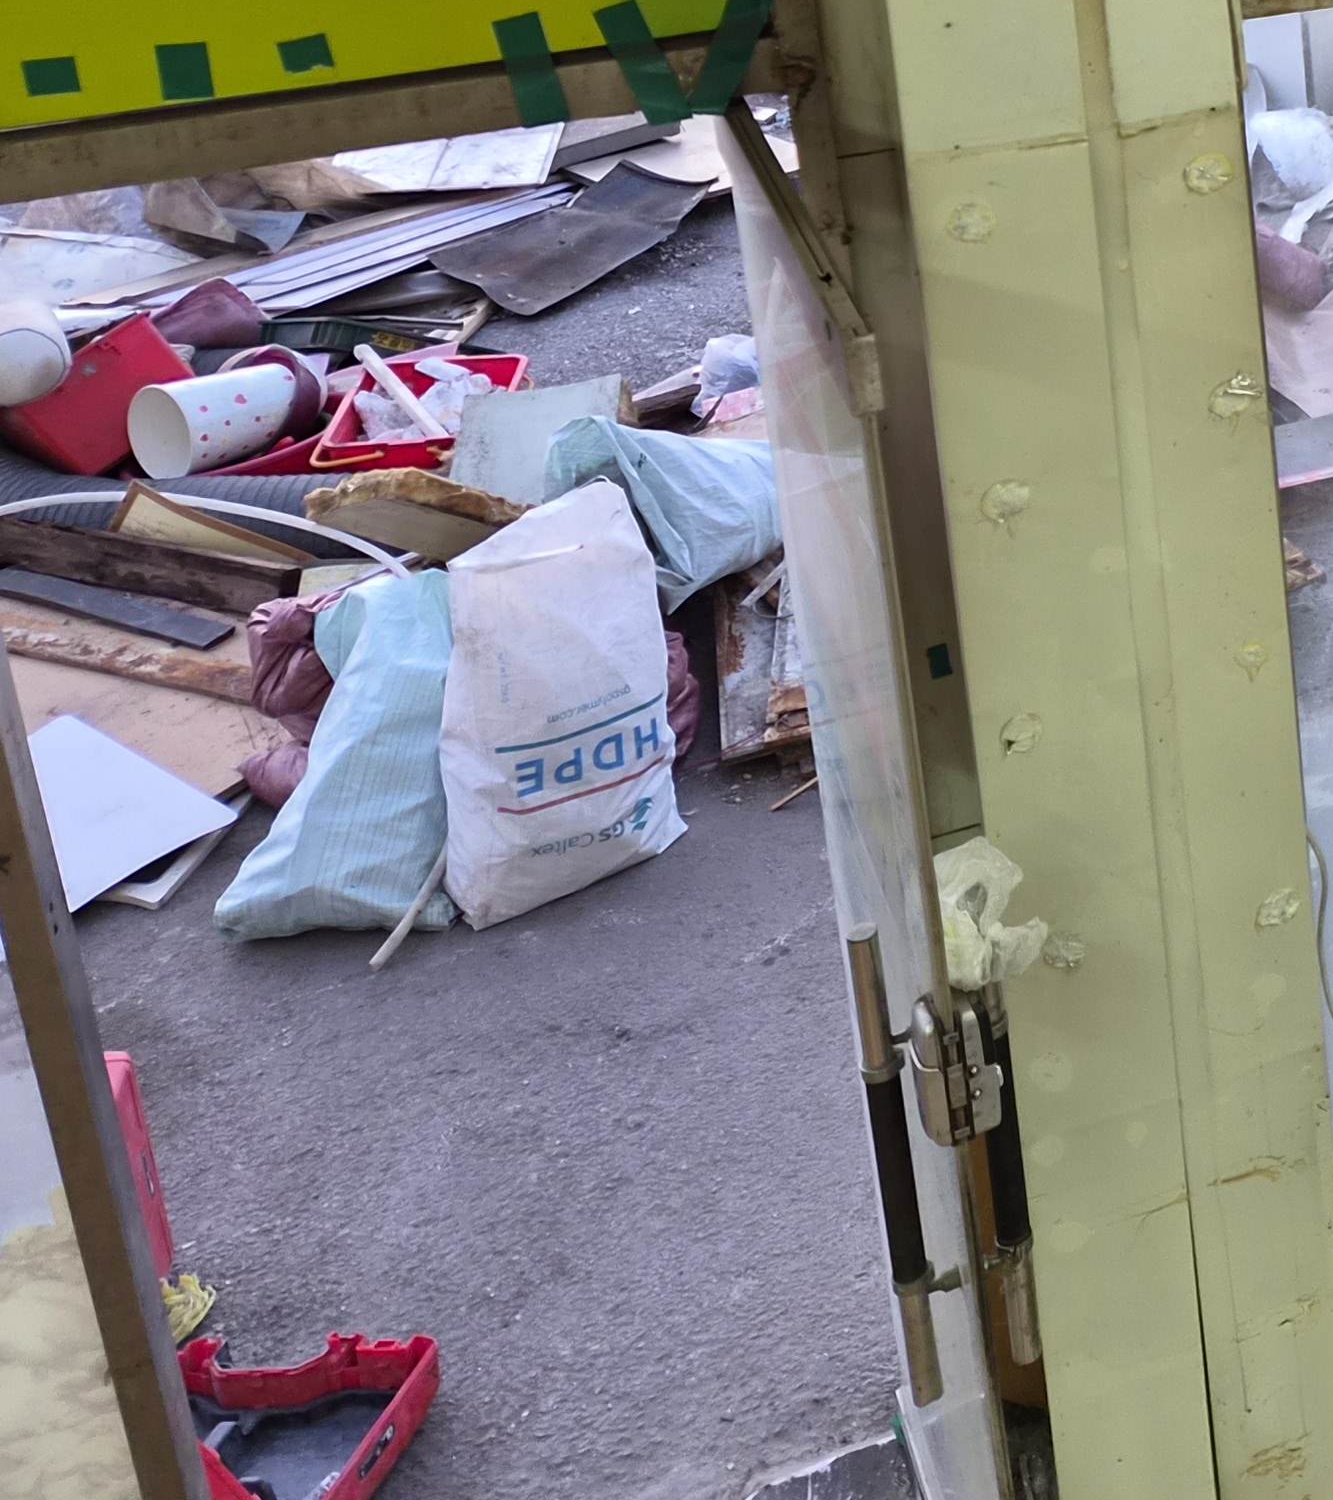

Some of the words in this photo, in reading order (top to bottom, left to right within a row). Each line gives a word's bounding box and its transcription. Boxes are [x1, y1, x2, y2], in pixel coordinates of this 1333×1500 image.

[514, 717, 660, 798] HDPE
[598, 820, 625, 843] GS
[531, 832, 595, 858] Caltex
